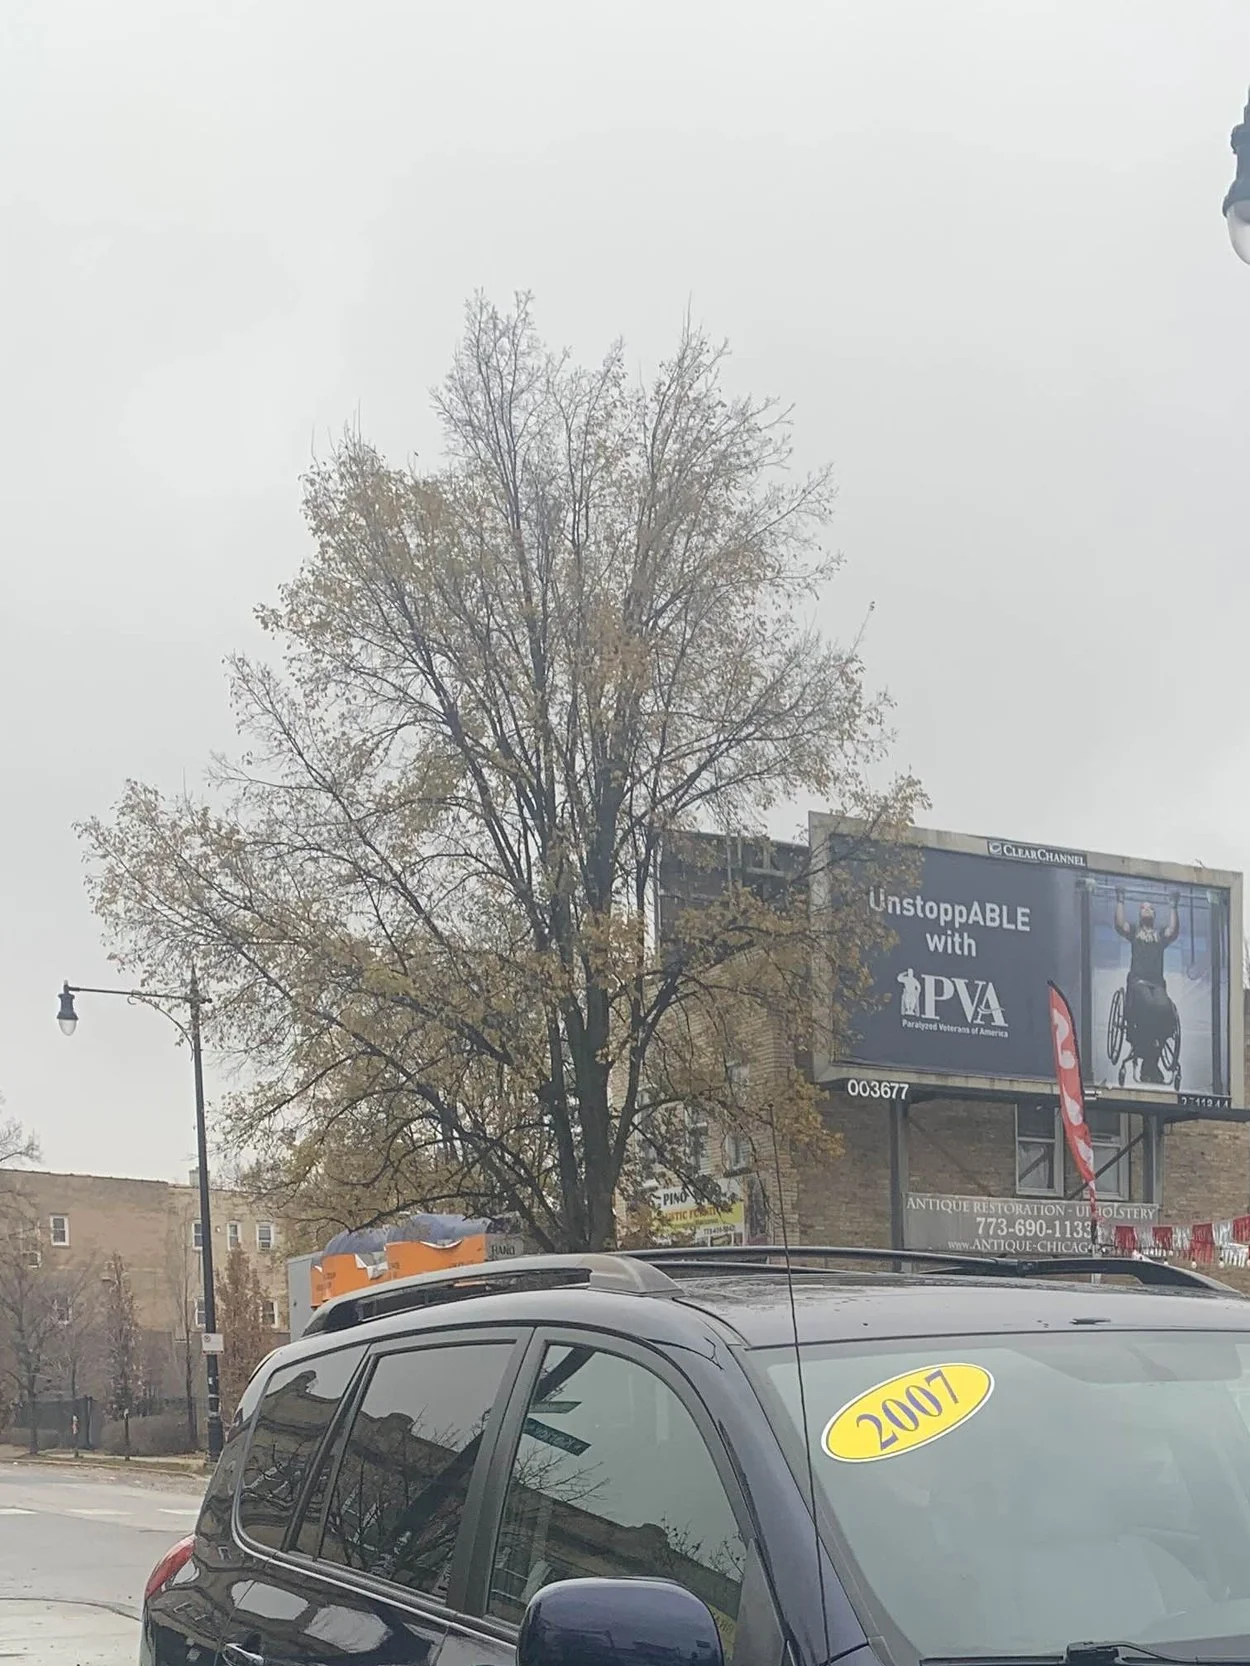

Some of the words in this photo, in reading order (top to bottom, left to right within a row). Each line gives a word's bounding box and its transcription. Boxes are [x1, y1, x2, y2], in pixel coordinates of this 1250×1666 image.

[869, 886, 1031, 932] UnstoppABLE
[926, 930, 977, 957] with
[920, 974, 1009, 1027] PVA
[902, 1019, 938, 1031] Paralyzed
[939, 1023, 970, 1034] Veterans
[971, 1027, 979, 1035] of
[980, 1027, 1009, 1038] America
[847, 1079, 909, 1100] 003677
[906, 1198, 969, 1214] ANTIQUE
[973, 1201, 1065, 1216] RESTORATION
[976, 1217, 1092, 1239] 773-690-1133
[856, 1369, 959, 1451] 2007
